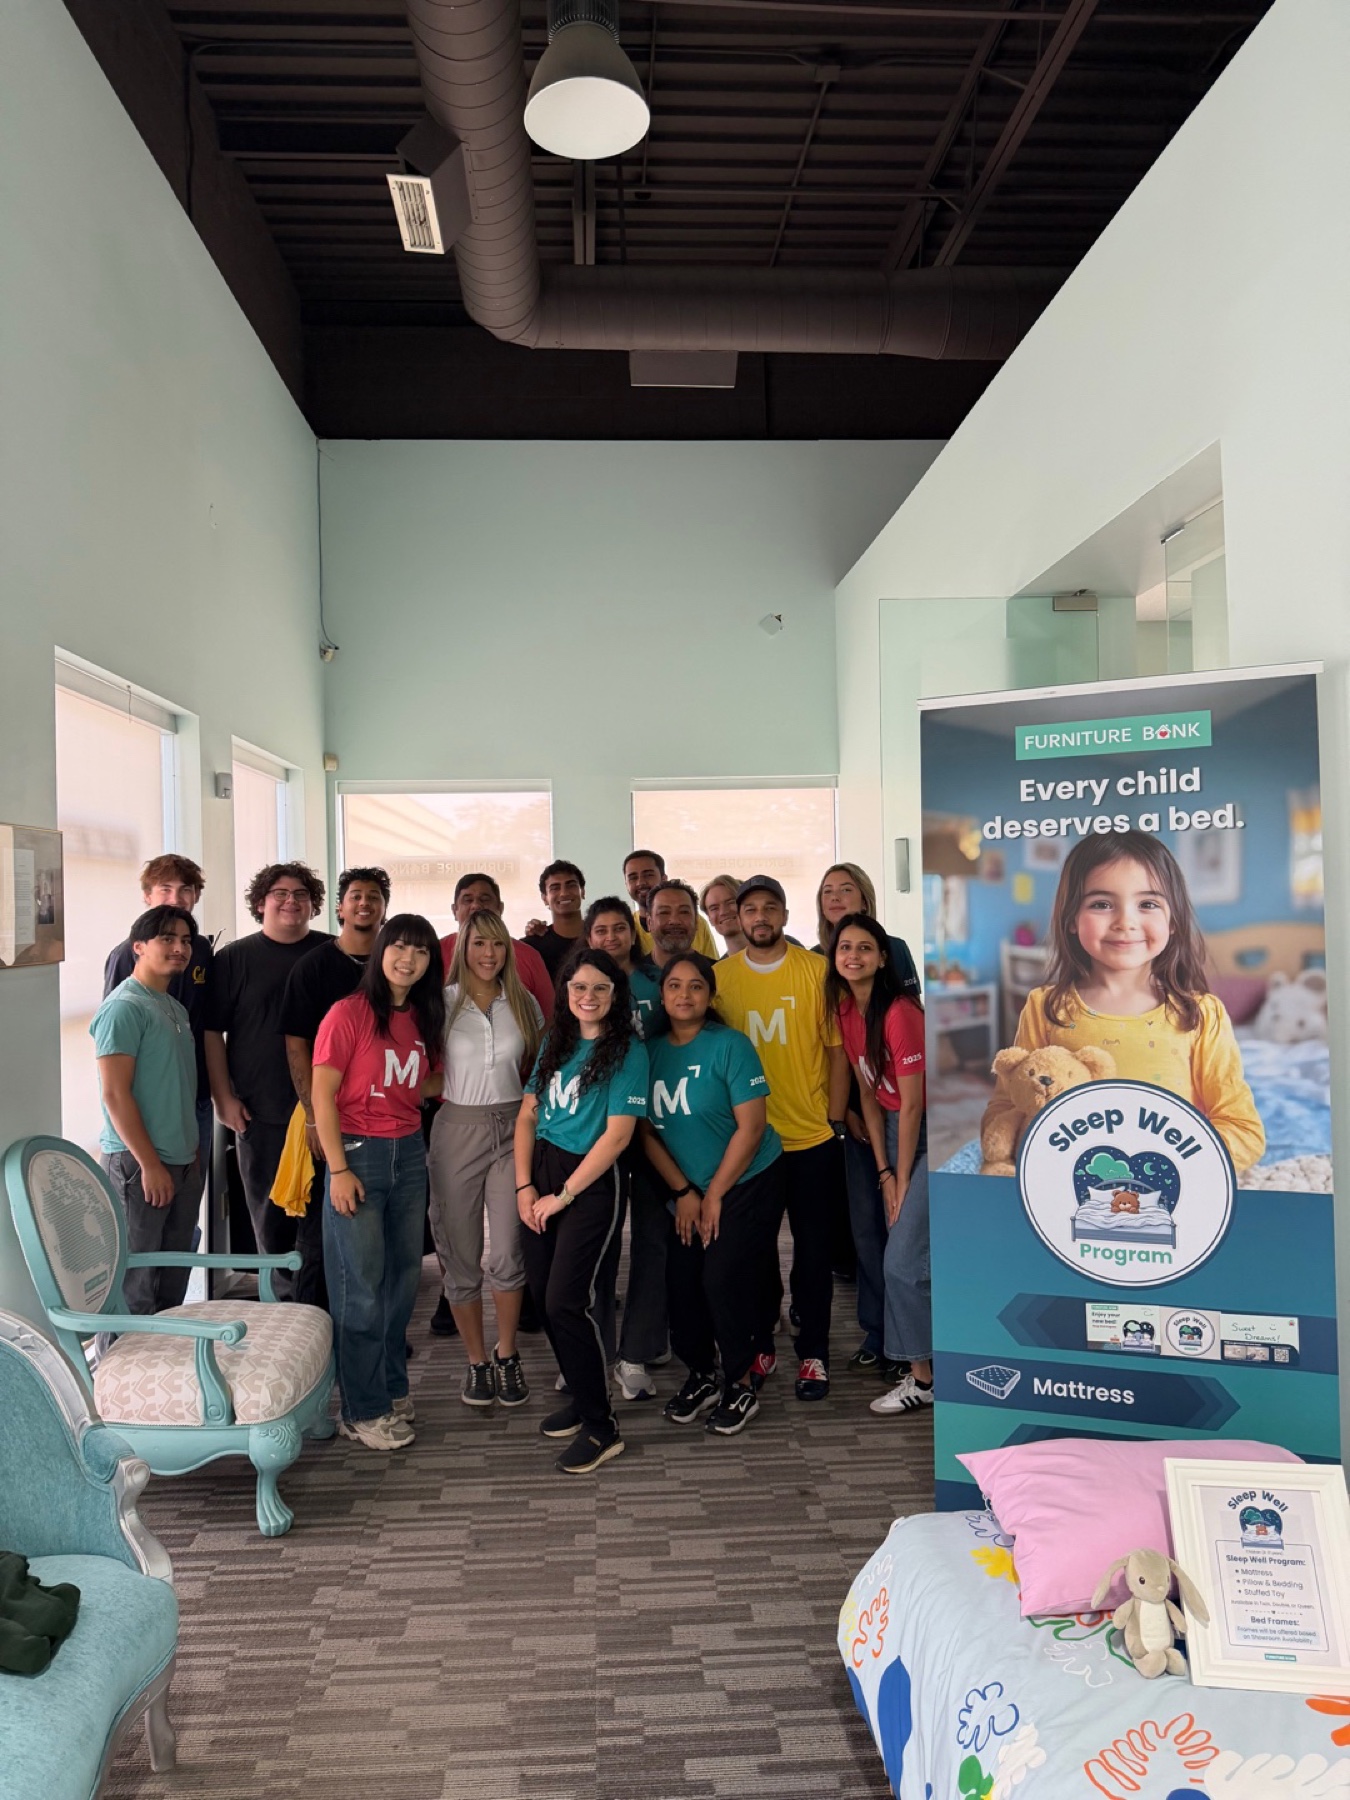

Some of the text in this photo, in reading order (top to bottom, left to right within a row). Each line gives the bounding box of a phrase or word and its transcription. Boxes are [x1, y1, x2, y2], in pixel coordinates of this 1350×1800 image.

[1024, 728, 1132, 750] FURNITURE
[1020, 766, 1201, 806] Every child
[982, 804, 1245, 840] deserves a bed.
[748, 1008, 787, 1047] M
[384, 1049, 420, 1089] M
[902, 1052, 922, 1065] 2025
[550, 1070, 581, 1115] M
[627, 1096, 646, 1106] 2025
[653, 1076, 692, 1118] M
[1049, 1106, 1203, 1160] Sleep Well
[1080, 1244, 1173, 1266] Program
[1232, 1322, 1256, 1332] Sweet
[1244, 1333, 1280, 1342] Dreams!
[1033, 1377, 1135, 1404] Mattress
[1227, 1490, 1289, 1512] Sleep Well
[1226, 1554, 1306, 1566] Sleep Well Program:
[1240, 1568, 1273, 1576] Mattress
[1242, 1578, 1264, 1586] Pillow
[1272, 1580, 1304, 1590] Bedding
[1244, 1588, 1286, 1598] Stuffed Toy
[1250, 1616, 1300, 1626] Bed Frames:
